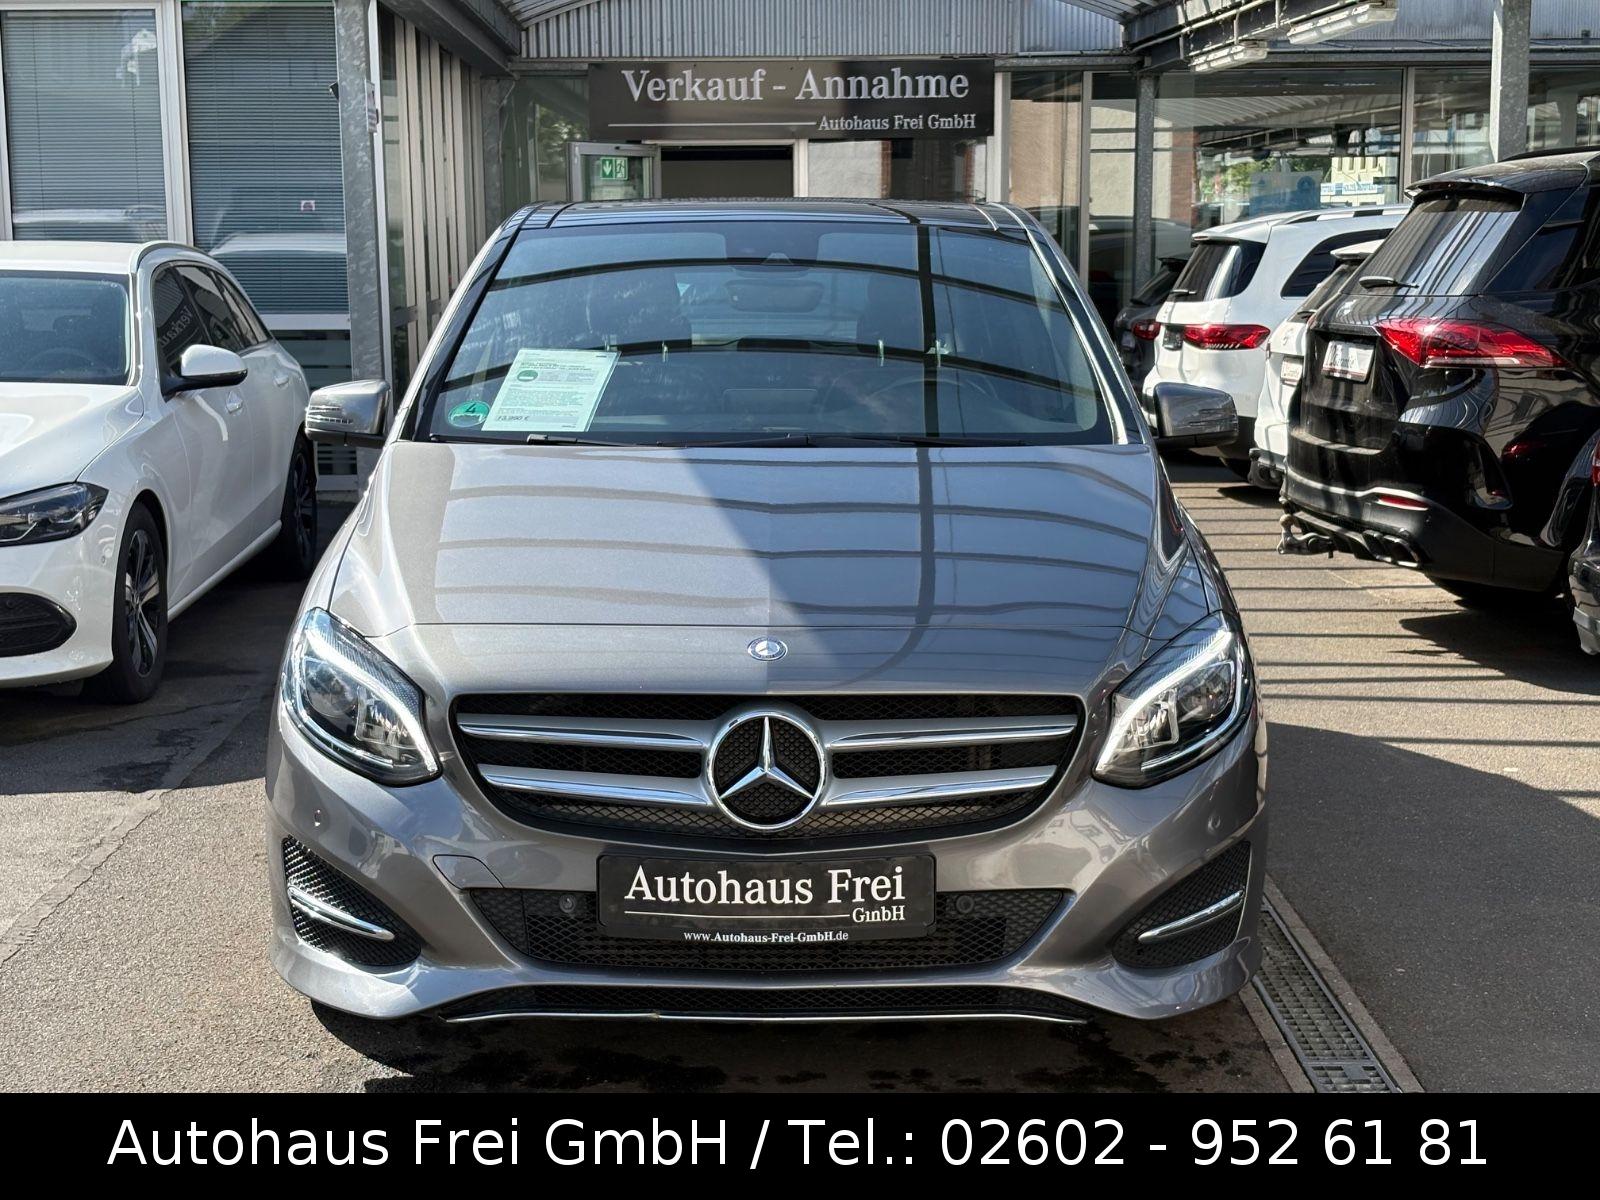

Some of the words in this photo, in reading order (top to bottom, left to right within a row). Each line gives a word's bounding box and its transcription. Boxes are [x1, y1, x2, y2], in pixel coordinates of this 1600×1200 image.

[621, 68, 767, 102] Verkauf
[795, 67, 970, 101] Annahme
[818, 115, 889, 131] Autohaus
[893, 114, 924, 130] Frei
[927, 113, 976, 130] GmbH
[465, 402, 477, 414] 4
[624, 865, 814, 905] Autohaus
[827, 866, 906, 904] Frei
[852, 905, 906, 923] GmbH
[684, 930, 849, 943] www.Autohaus-Frei-GmbH.de
